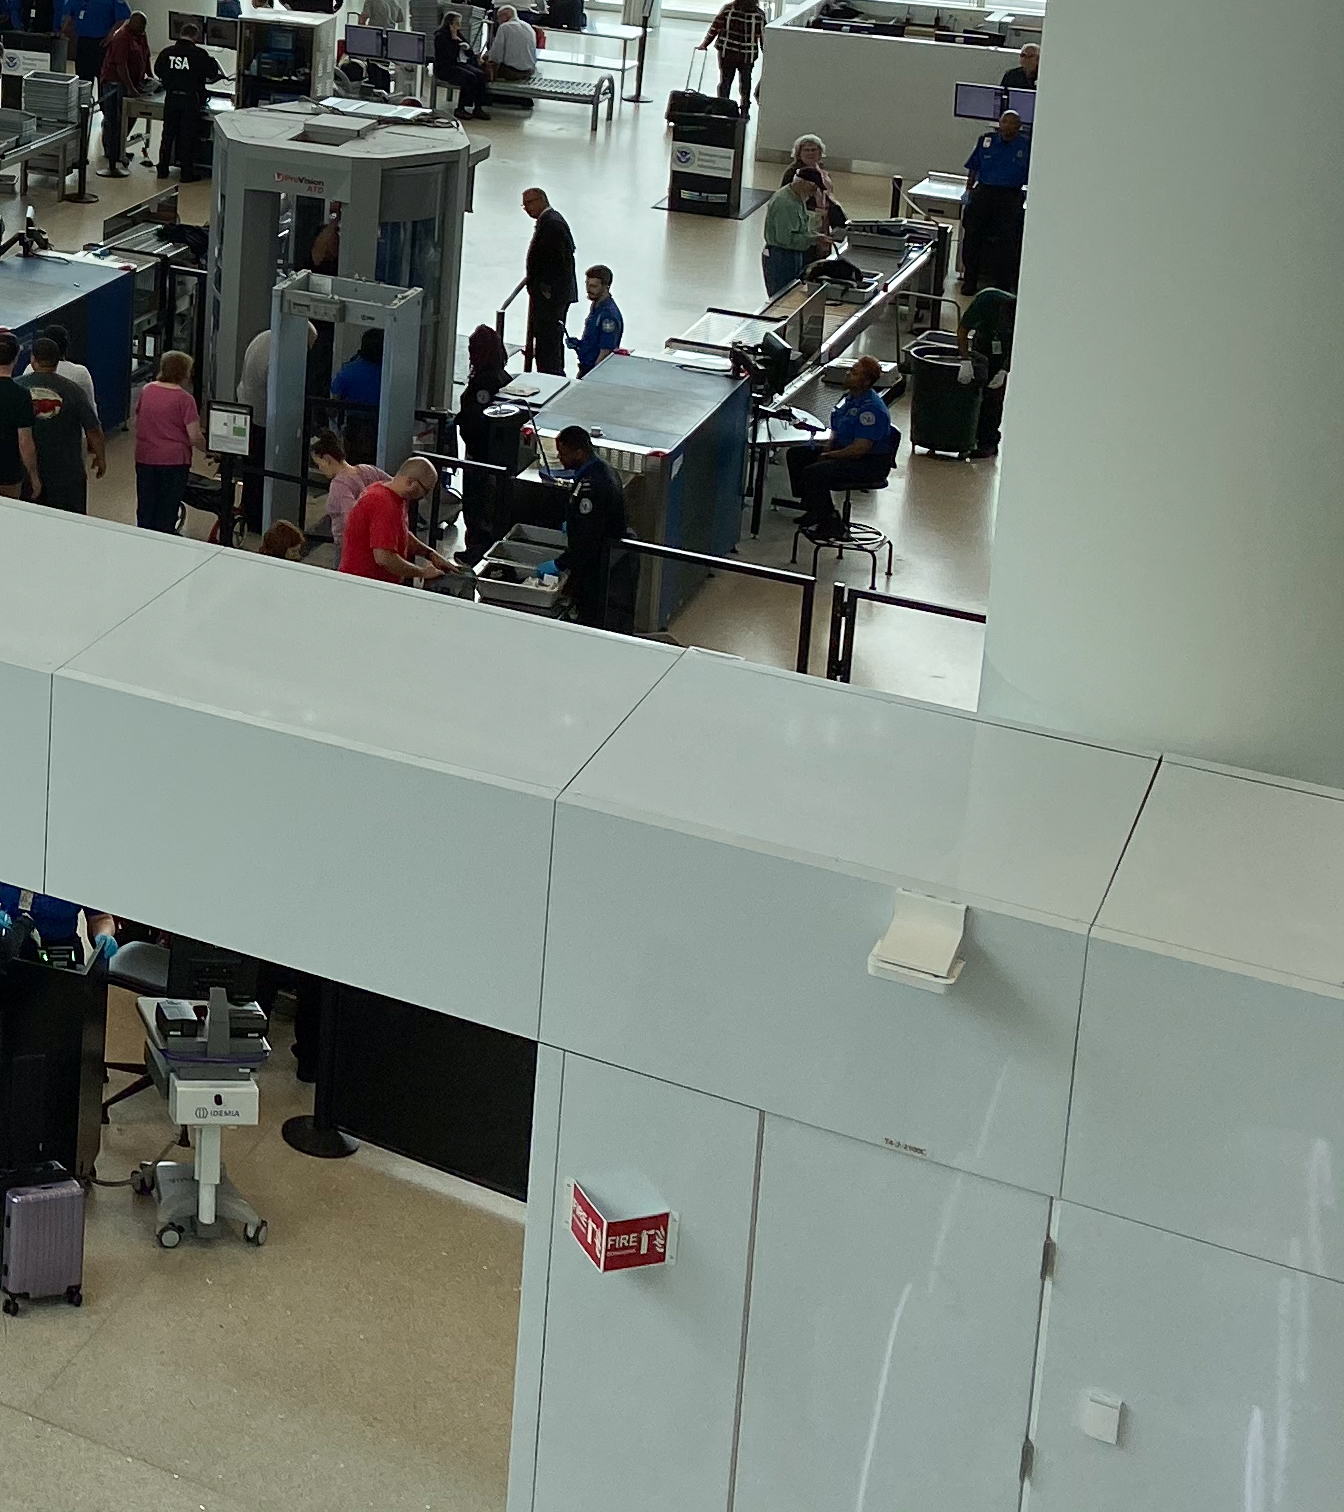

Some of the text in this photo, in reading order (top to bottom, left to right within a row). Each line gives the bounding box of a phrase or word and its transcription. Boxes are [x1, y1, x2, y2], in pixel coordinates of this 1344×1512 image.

[168, 55, 190, 71] TSA
[306, 185, 325, 194] ATD
[210, 1109, 240, 1117] IDEMIA
[607, 1232, 639, 1250] FIRE
